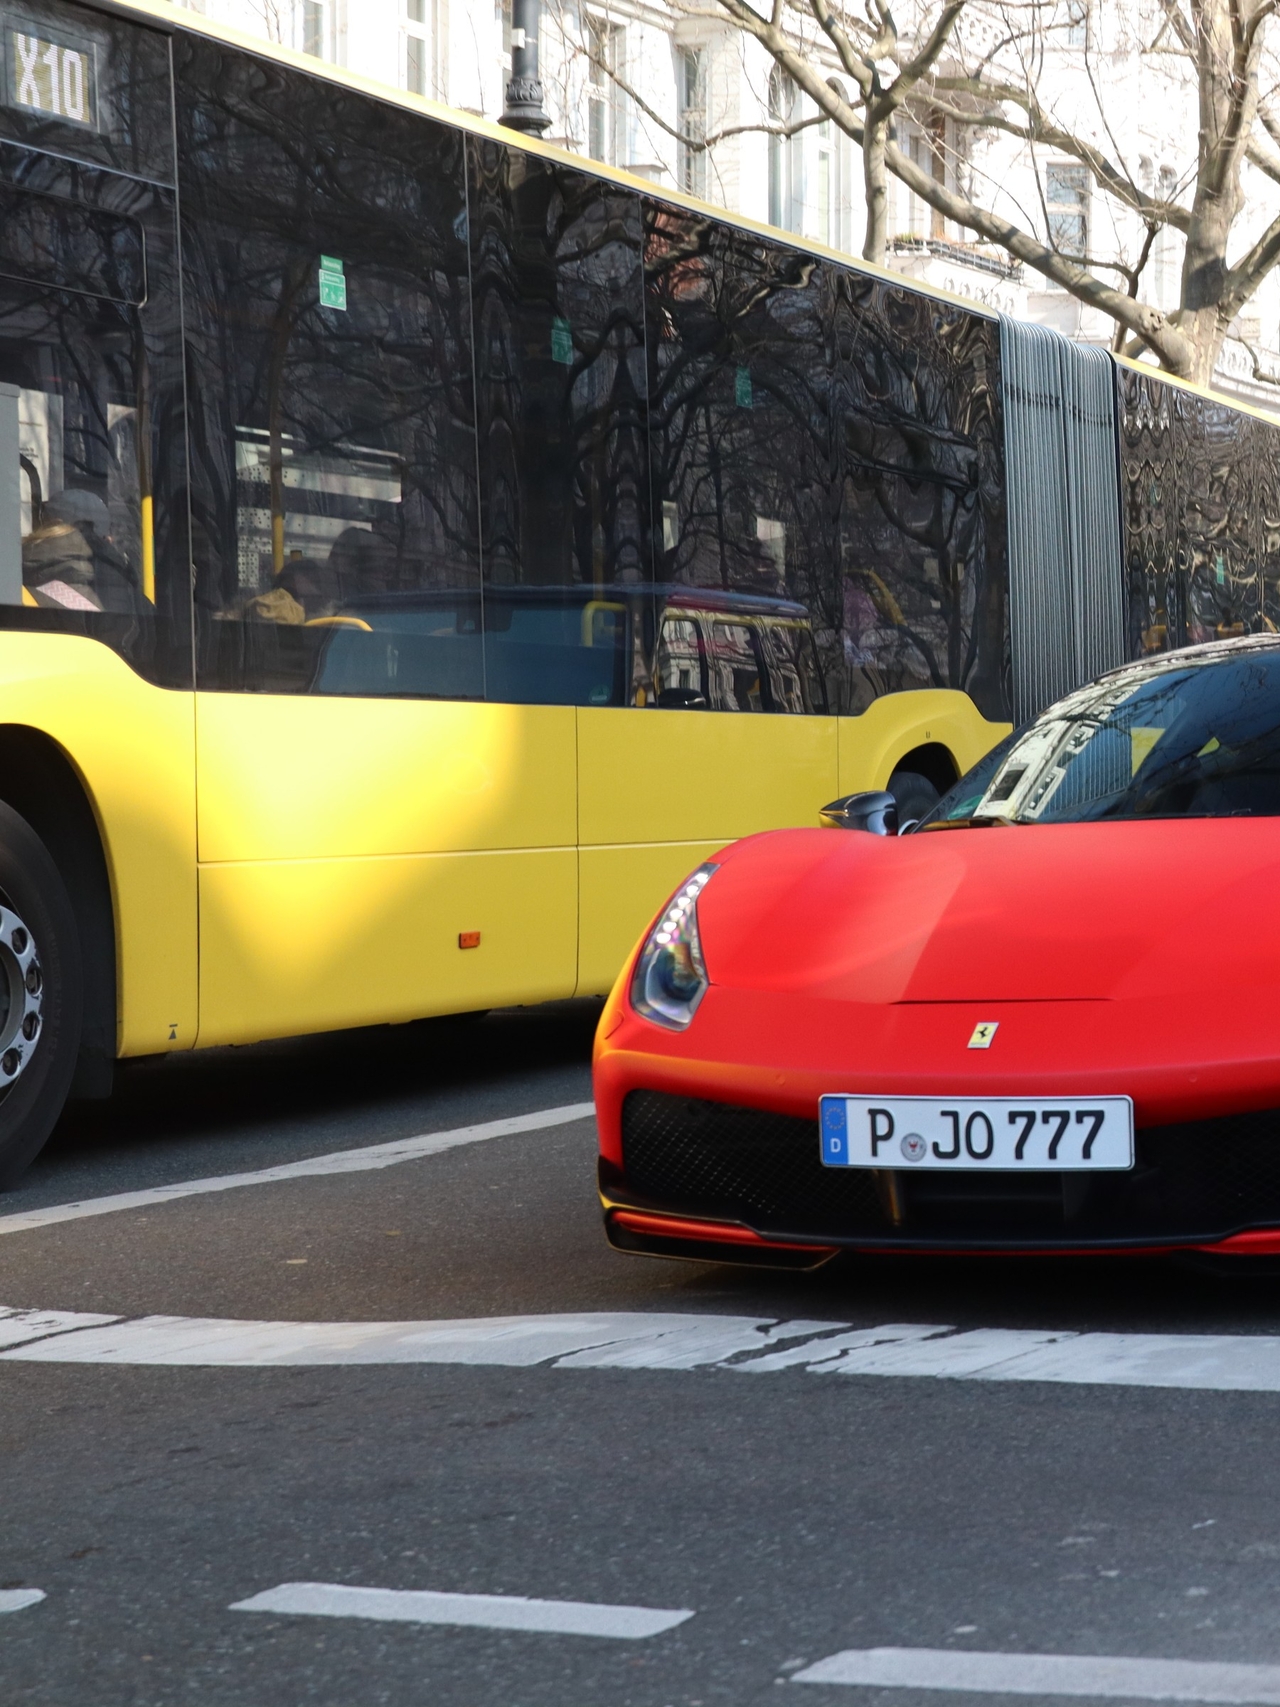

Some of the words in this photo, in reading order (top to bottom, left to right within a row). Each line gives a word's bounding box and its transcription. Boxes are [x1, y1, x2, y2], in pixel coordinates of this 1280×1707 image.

[17, 33, 84, 121] X10
[830, 1138, 841, 1153] D
[867, 1108, 895, 1157] P
[932, 1110, 994, 1160] JO
[1008, 1110, 1105, 1160] 777
